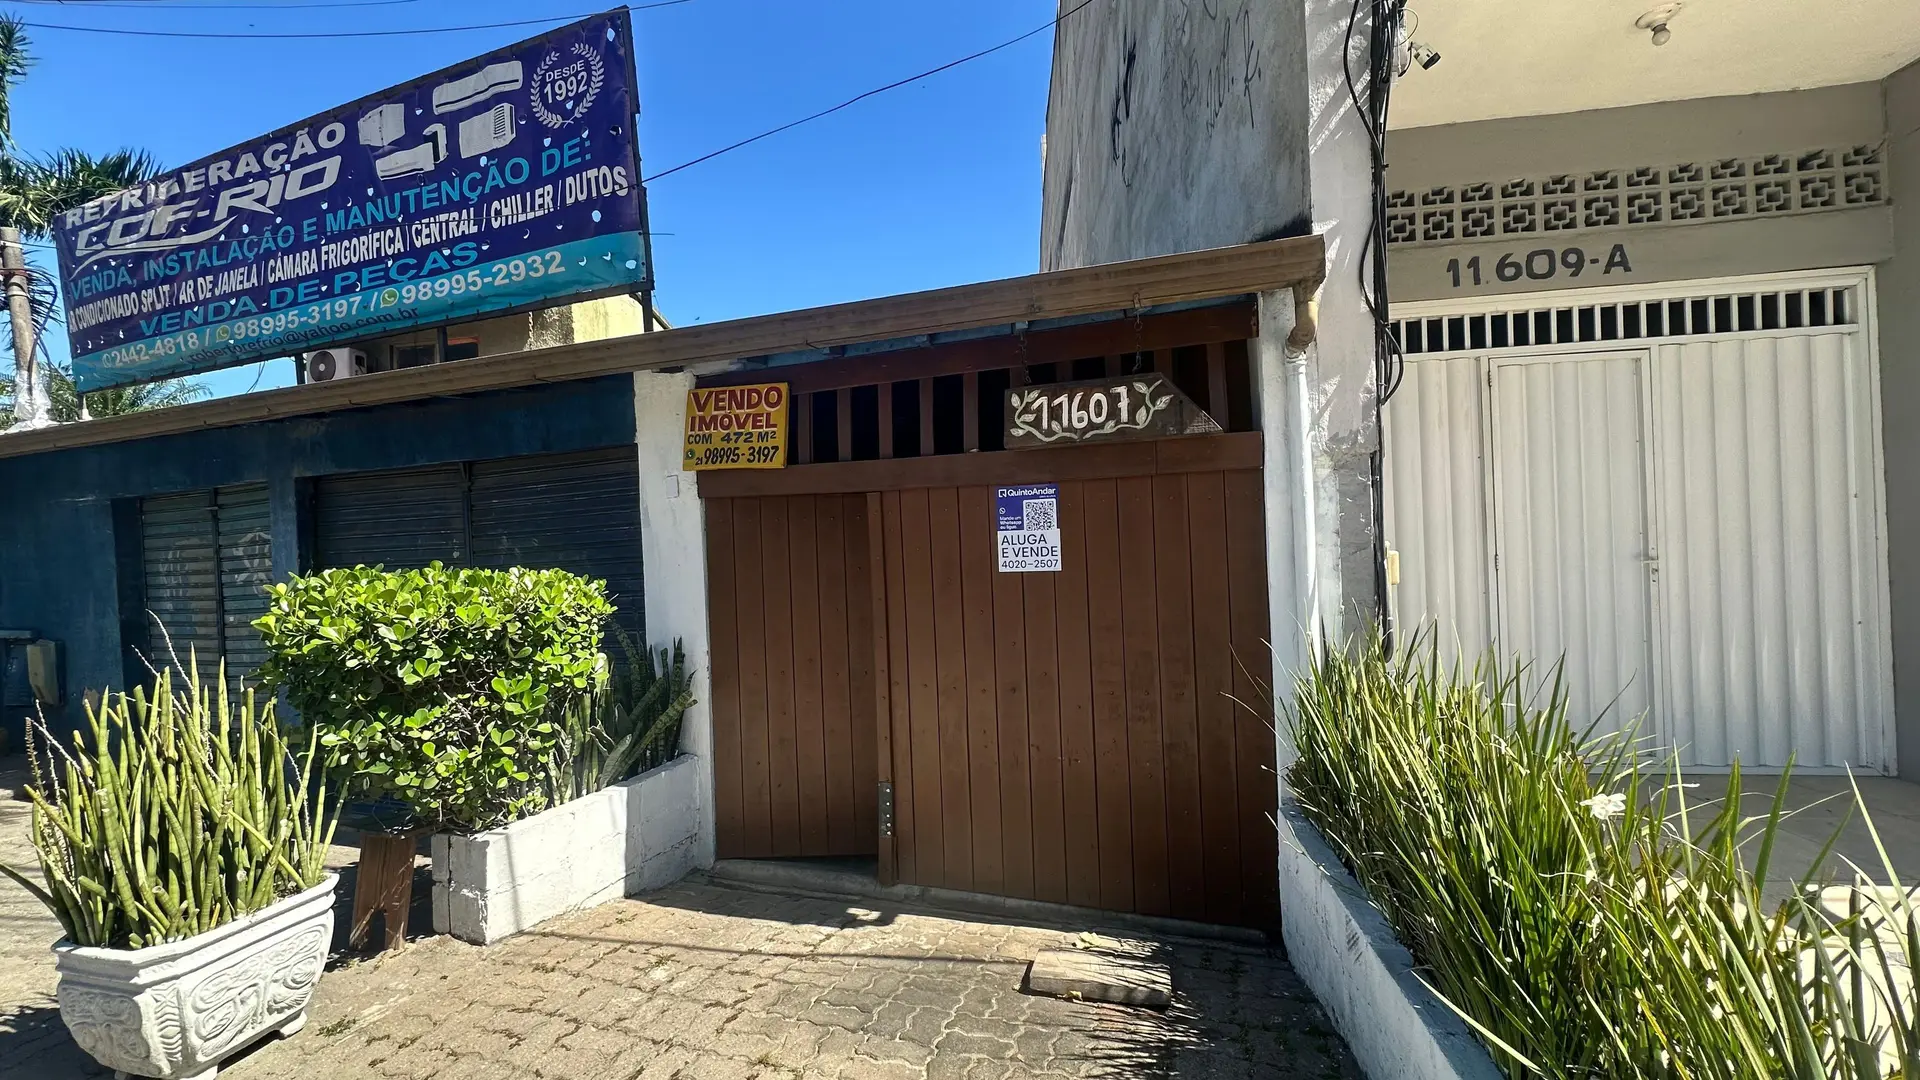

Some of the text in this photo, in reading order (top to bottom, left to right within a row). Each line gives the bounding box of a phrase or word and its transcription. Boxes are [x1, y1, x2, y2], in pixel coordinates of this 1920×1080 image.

[546, 60, 585, 82] DESDE
[544, 71, 588, 104] 1992
[71, 137, 592, 300] VENDA, INSTALAÇÃO E MANUTENÇÃO DE:
[76, 292, 140, 330] CONDICIONADO
[141, 284, 170, 313] SPLIT
[179, 279, 196, 305] AR
[197, 275, 214, 300] DE
[214, 270, 259, 296] JANELA
[267, 254, 319, 283] CÂMARA
[321, 225, 405, 270] FRIGORÍFICA
[412, 207, 478, 249] CENTRAL
[490, 183, 554, 229] CHILLER
[565, 165, 629, 205] DUTOS
[139, 241, 478, 336] VENDA DE PEÇAS
[111, 332, 199, 368] 2442-4818
[233, 296, 361, 339] 98995-3197
[401, 251, 566, 304] 98995-2932
[691, 386, 783, 414] VENDO
[1030, 385, 1130, 430] 11607
[689, 411, 777, 433] IMÓVEL
[687, 433, 712, 444] COM
[720, 432, 754, 444] 472
[704, 445, 780, 465] 98995-3197
[1007, 487, 1056, 496] QuintoAndar
[1001, 534, 1048, 546] ALUGA
[1002, 546, 1058, 558] E VENDE
[1001, 559, 1059, 568] 4020-2507
